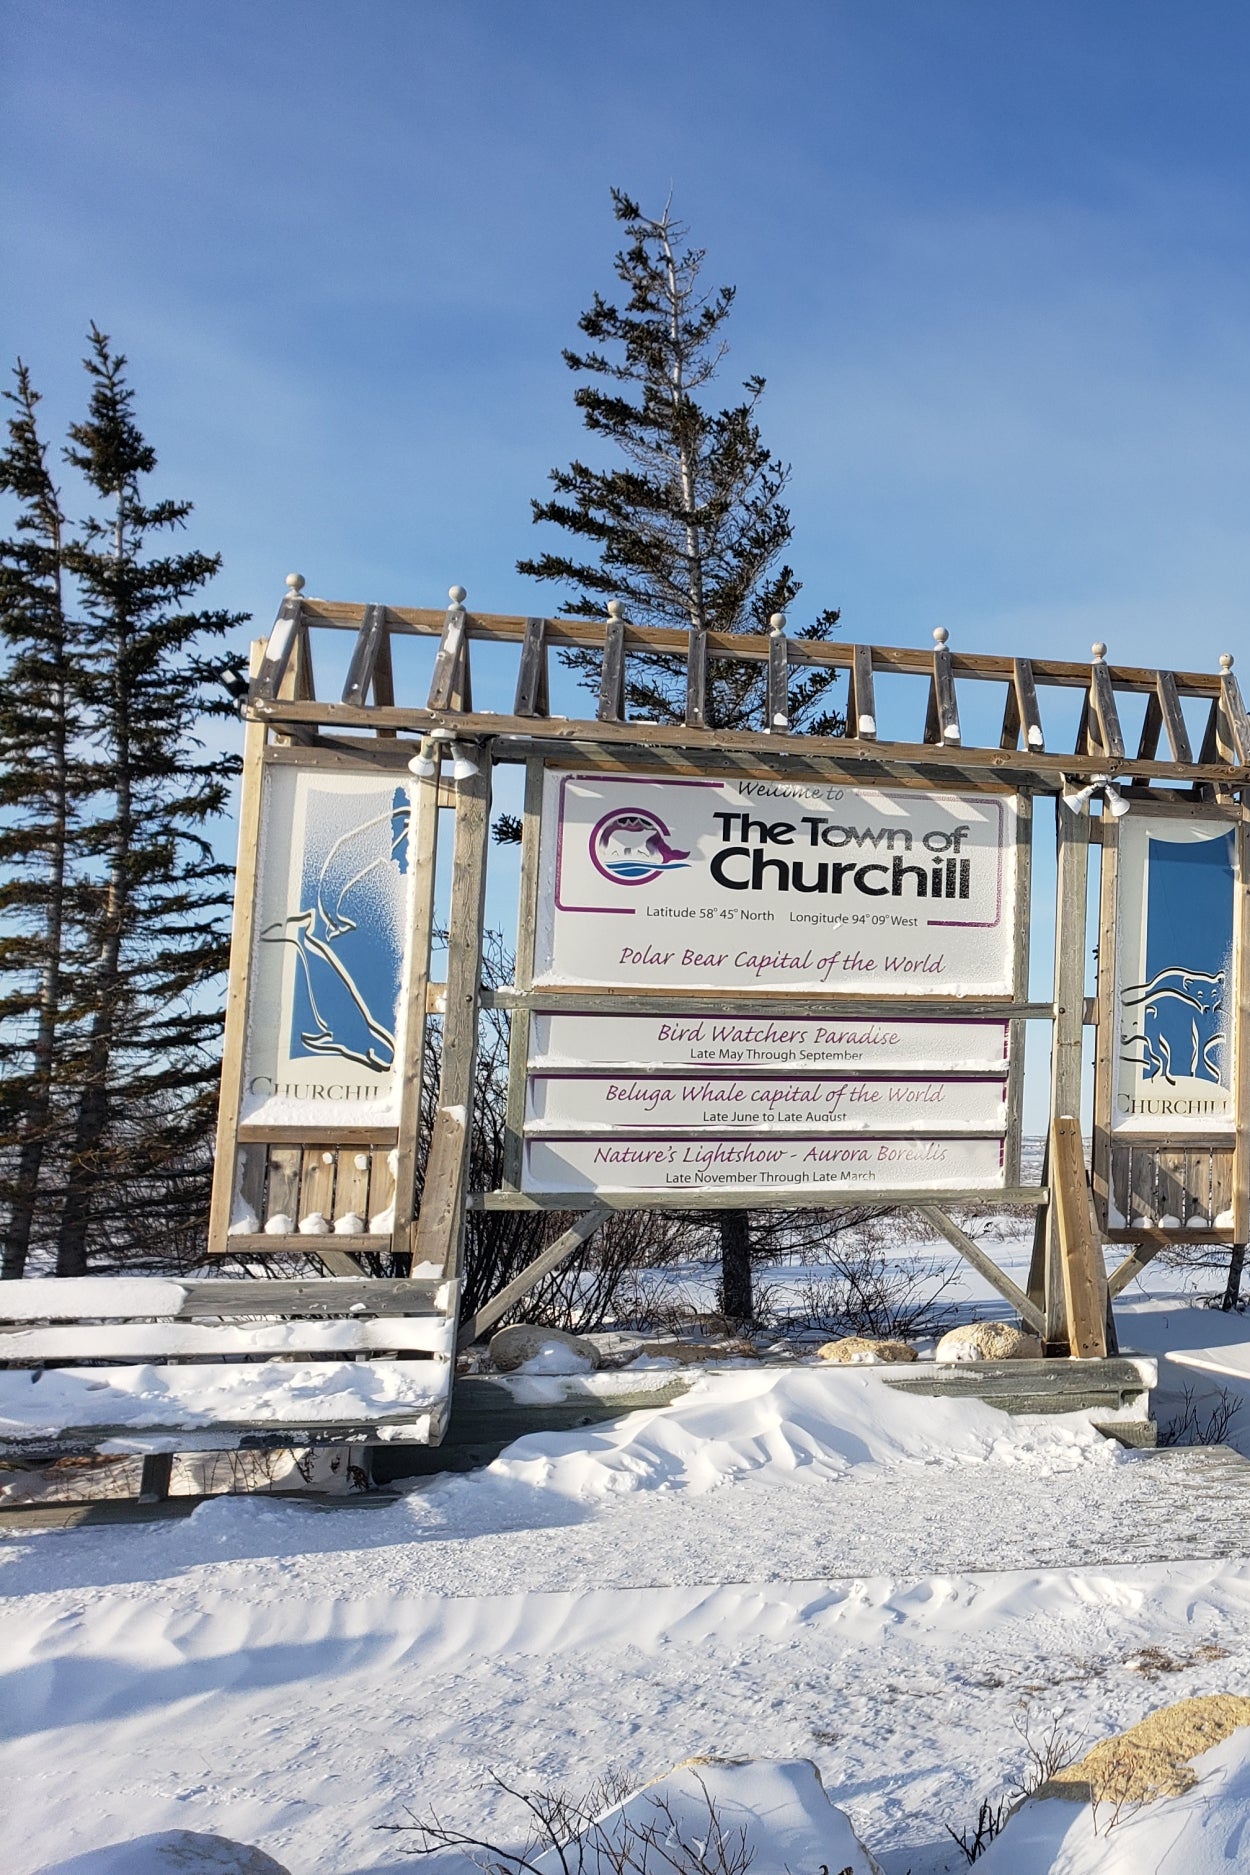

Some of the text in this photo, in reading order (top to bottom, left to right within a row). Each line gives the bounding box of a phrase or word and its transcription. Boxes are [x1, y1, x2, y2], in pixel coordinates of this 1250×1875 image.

[826, 785, 844, 800] to
[712, 811, 971, 854] The Town of
[710, 846, 971, 899] Churchill
[646, 906, 696, 918] Latitude
[740, 910, 775, 921] North
[790, 912, 849, 925] Longitude
[891, 916, 918, 926] West
[619, 945, 946, 982] Polar Bear Capital of the World
[657, 1021, 901, 1045] Bird Watchers Paradise
[690, 1048, 863, 1063] Late May Through September
[250, 1076, 393, 1101] CHURCHIL
[606, 1082, 945, 1114] Beluga Whale capital of the World
[703, 1111, 847, 1123] Late June to Late August
[682, 1143, 787, 1173] Lightshow
[803, 1146, 873, 1162] Aurora
[877, 1142, 948, 1163] Borealis
[666, 1171, 876, 1184] Late November Through Late March
